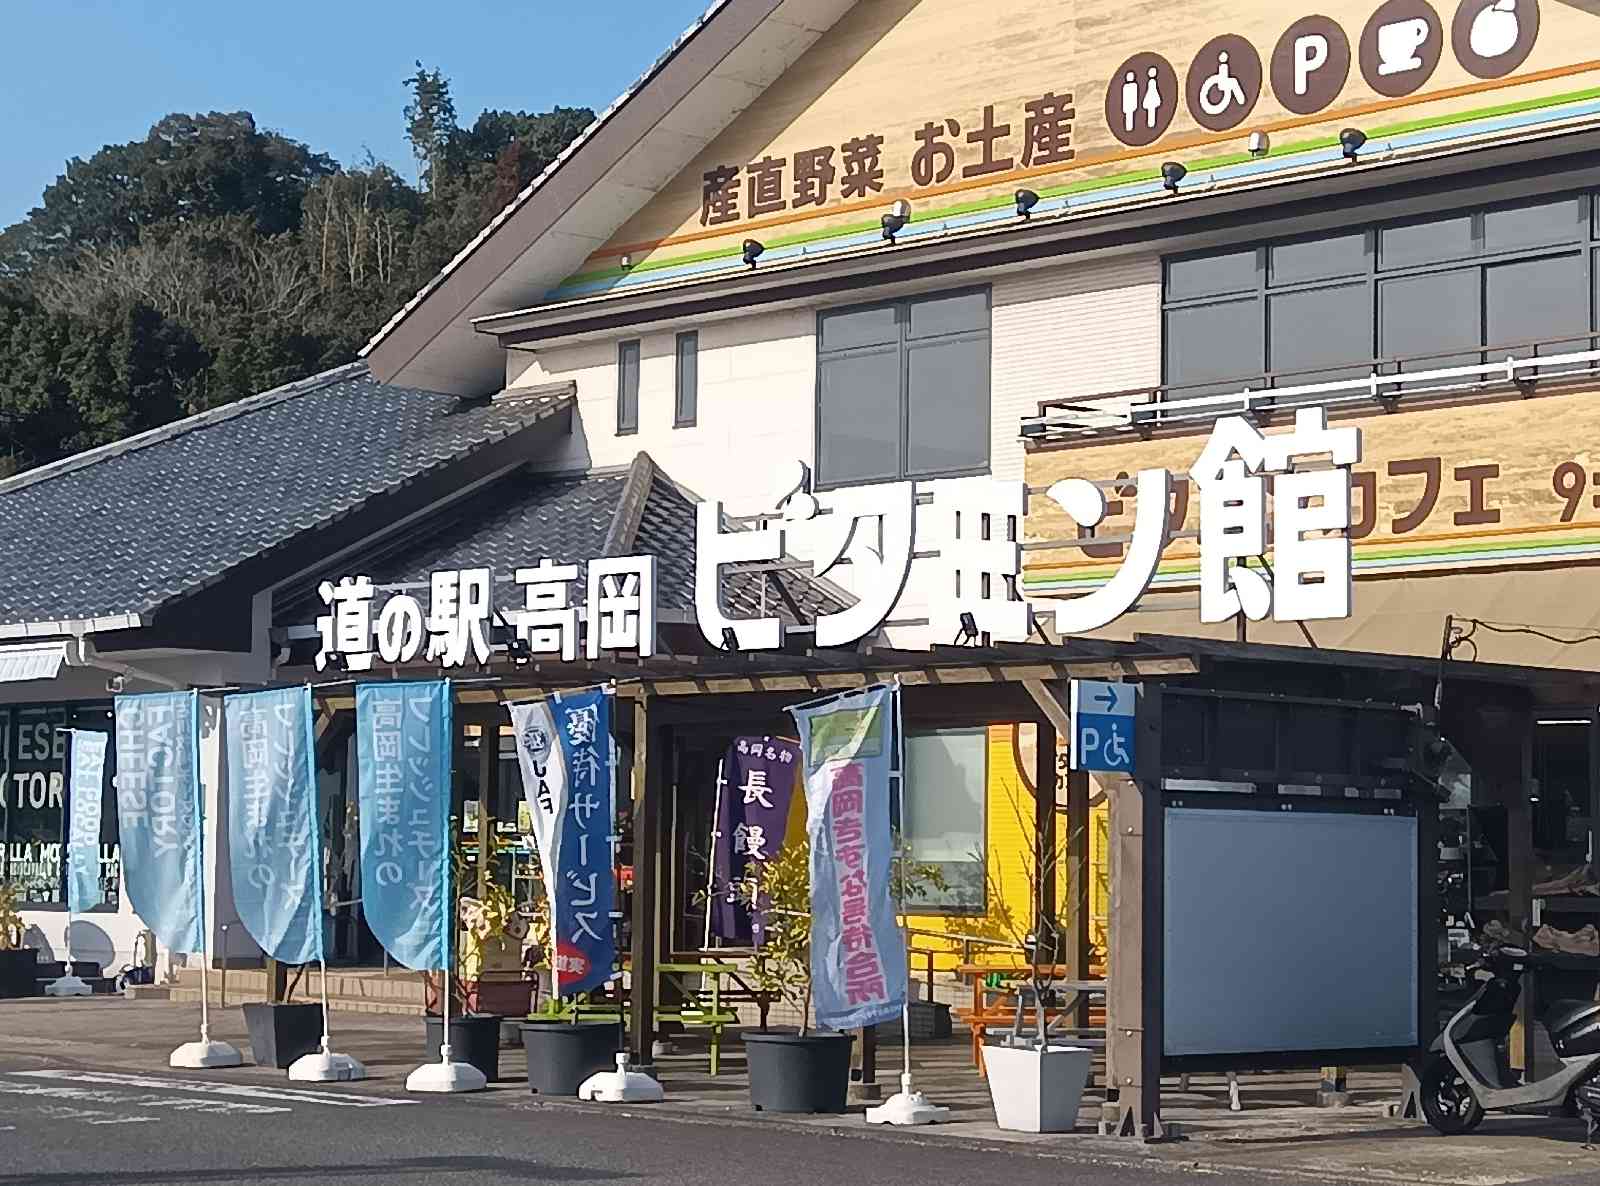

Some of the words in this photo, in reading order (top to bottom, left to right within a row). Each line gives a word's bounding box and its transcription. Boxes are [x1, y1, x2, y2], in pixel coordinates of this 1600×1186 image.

[700, 133, 884, 226] 産直野菜
[911, 92, 1075, 187] お土産
[315, 574, 492, 672] 道の駅
[515, 554, 656, 665] 高岡
[696, 405, 1362, 652] ビタミン館
[736, 739, 794, 765] 高岡名物
